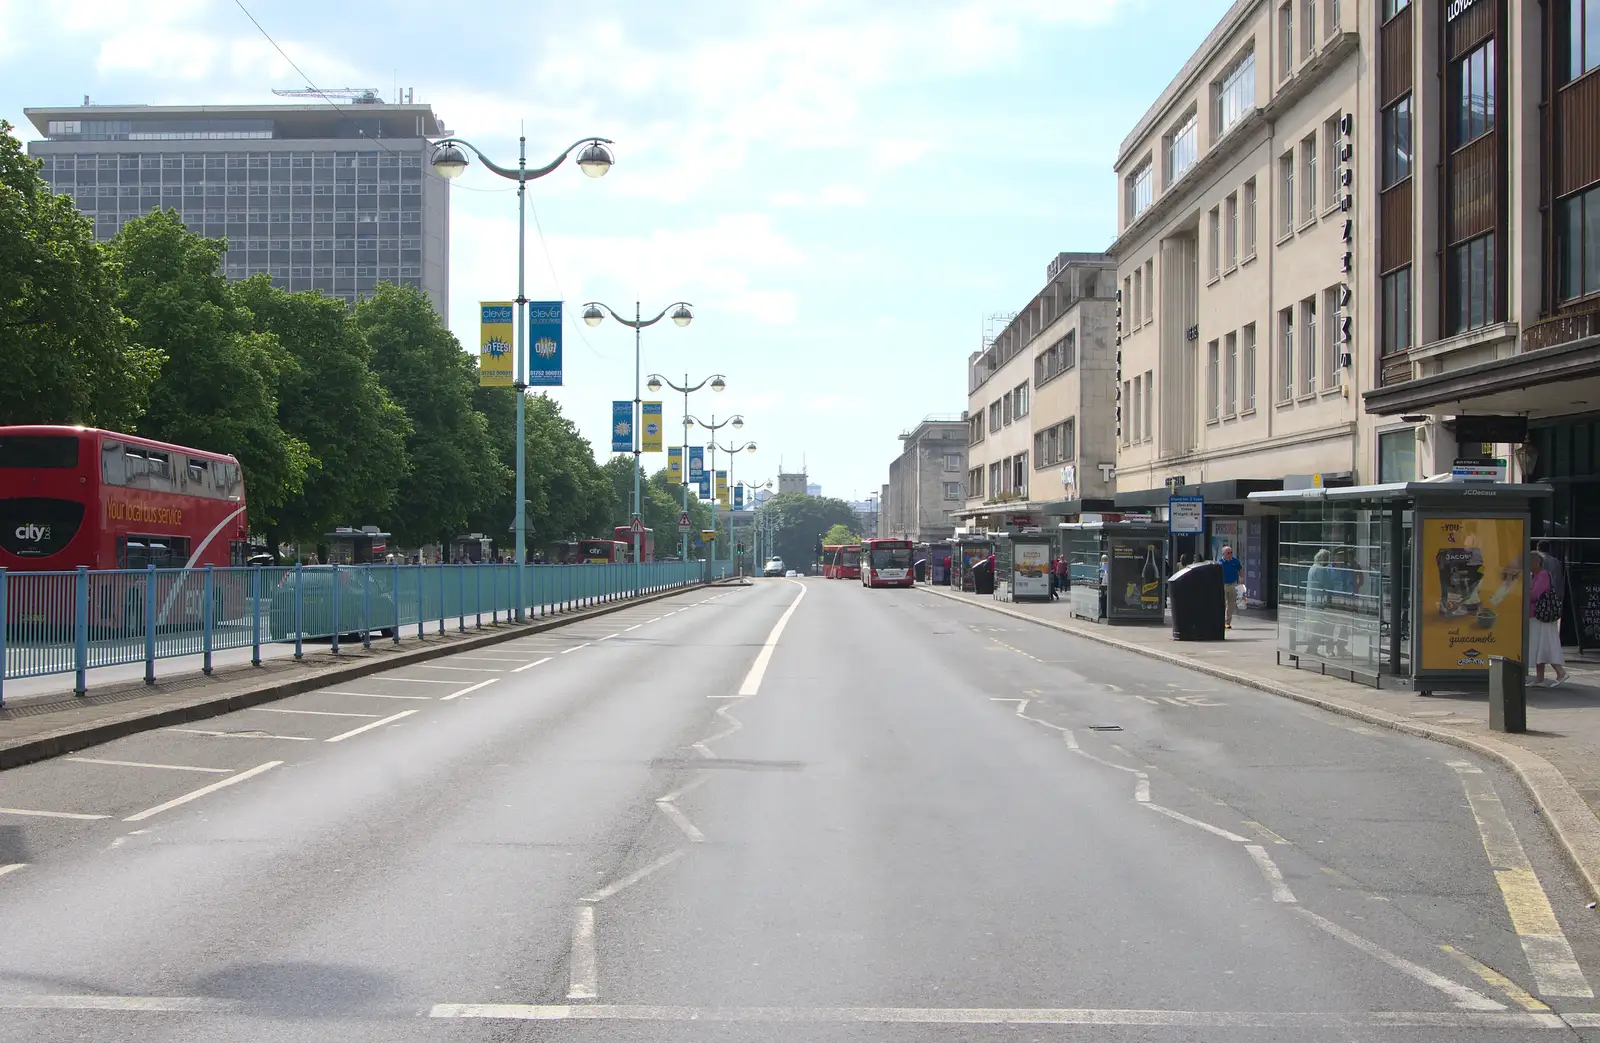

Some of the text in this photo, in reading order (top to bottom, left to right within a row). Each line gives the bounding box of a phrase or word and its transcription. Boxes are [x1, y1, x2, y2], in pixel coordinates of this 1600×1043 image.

[482, 343, 492, 354] NO
[107, 496, 183, 526] Your local bus service
[15, 522, 45, 543] city
[1444, 523, 1460, 532] YOU
[1448, 632, 1497, 648] guacamole
